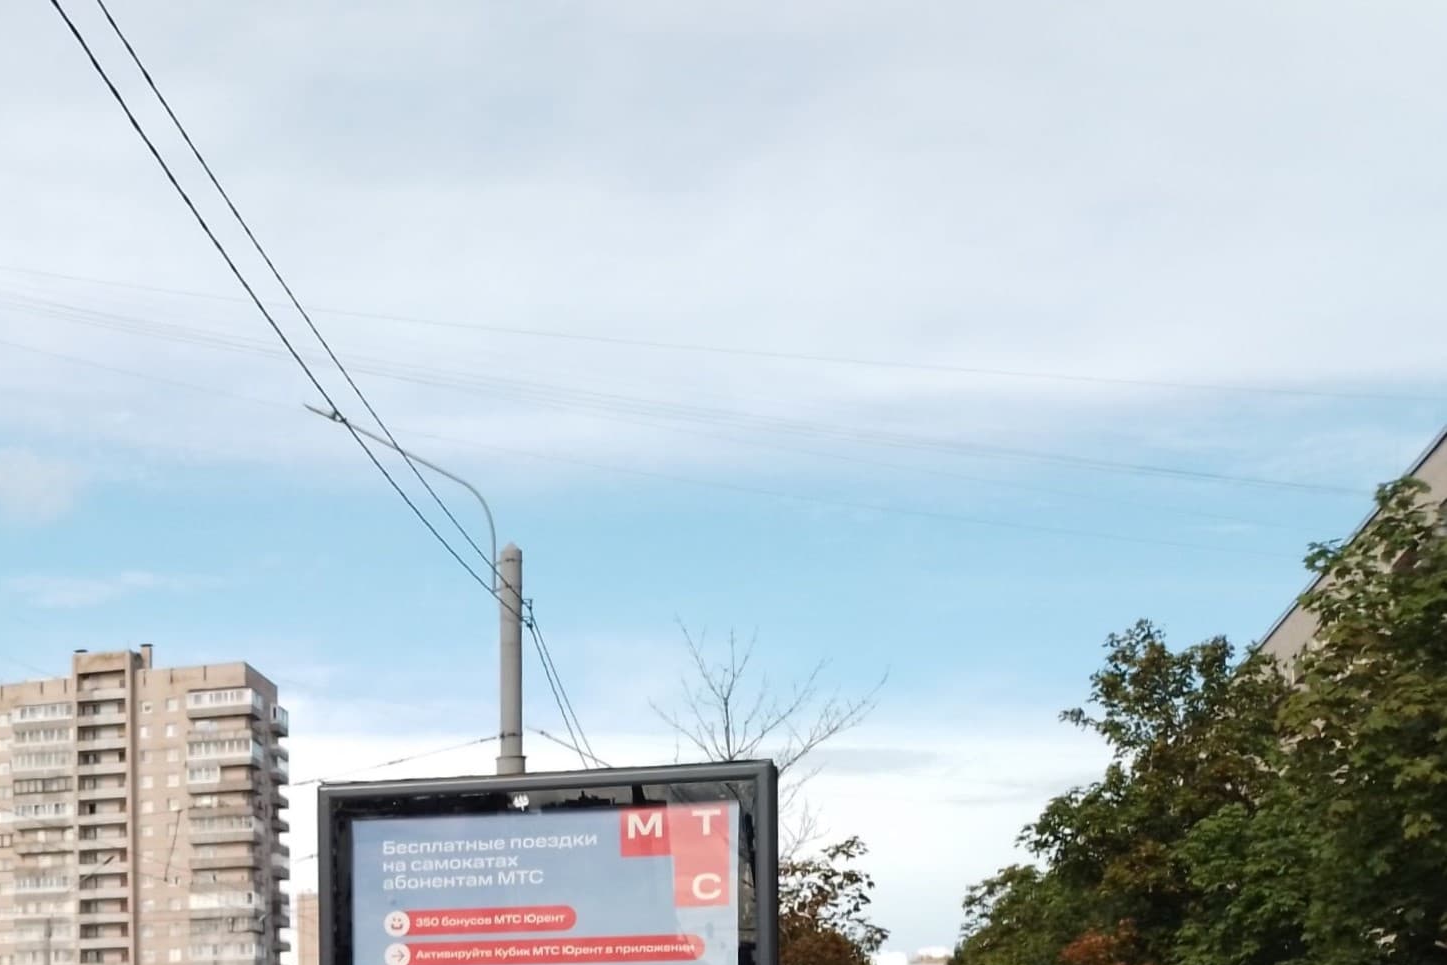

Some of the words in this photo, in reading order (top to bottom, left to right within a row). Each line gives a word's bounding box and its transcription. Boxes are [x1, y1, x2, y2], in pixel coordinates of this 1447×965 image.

[382, 837, 506, 856] Бесплатные
[510, 833, 598, 849] поездки
[382, 861, 407, 873] на
[410, 855, 519, 872] самокатах
[382, 872, 493, 890] абонентам
[497, 869, 544, 885] МТС
[415, 916, 440, 928] 350
[441, 915, 492, 927] бонусов
[494, 913, 521, 925] МТС
[523, 913, 566, 926] Юрент
[415, 948, 493, 961] Активируйте
[494, 946, 531, 960] Кубик
[532, 945, 560, 956] МТС
[562, 945, 603, 956] Юрент
[615, 943, 695, 955] приложении
